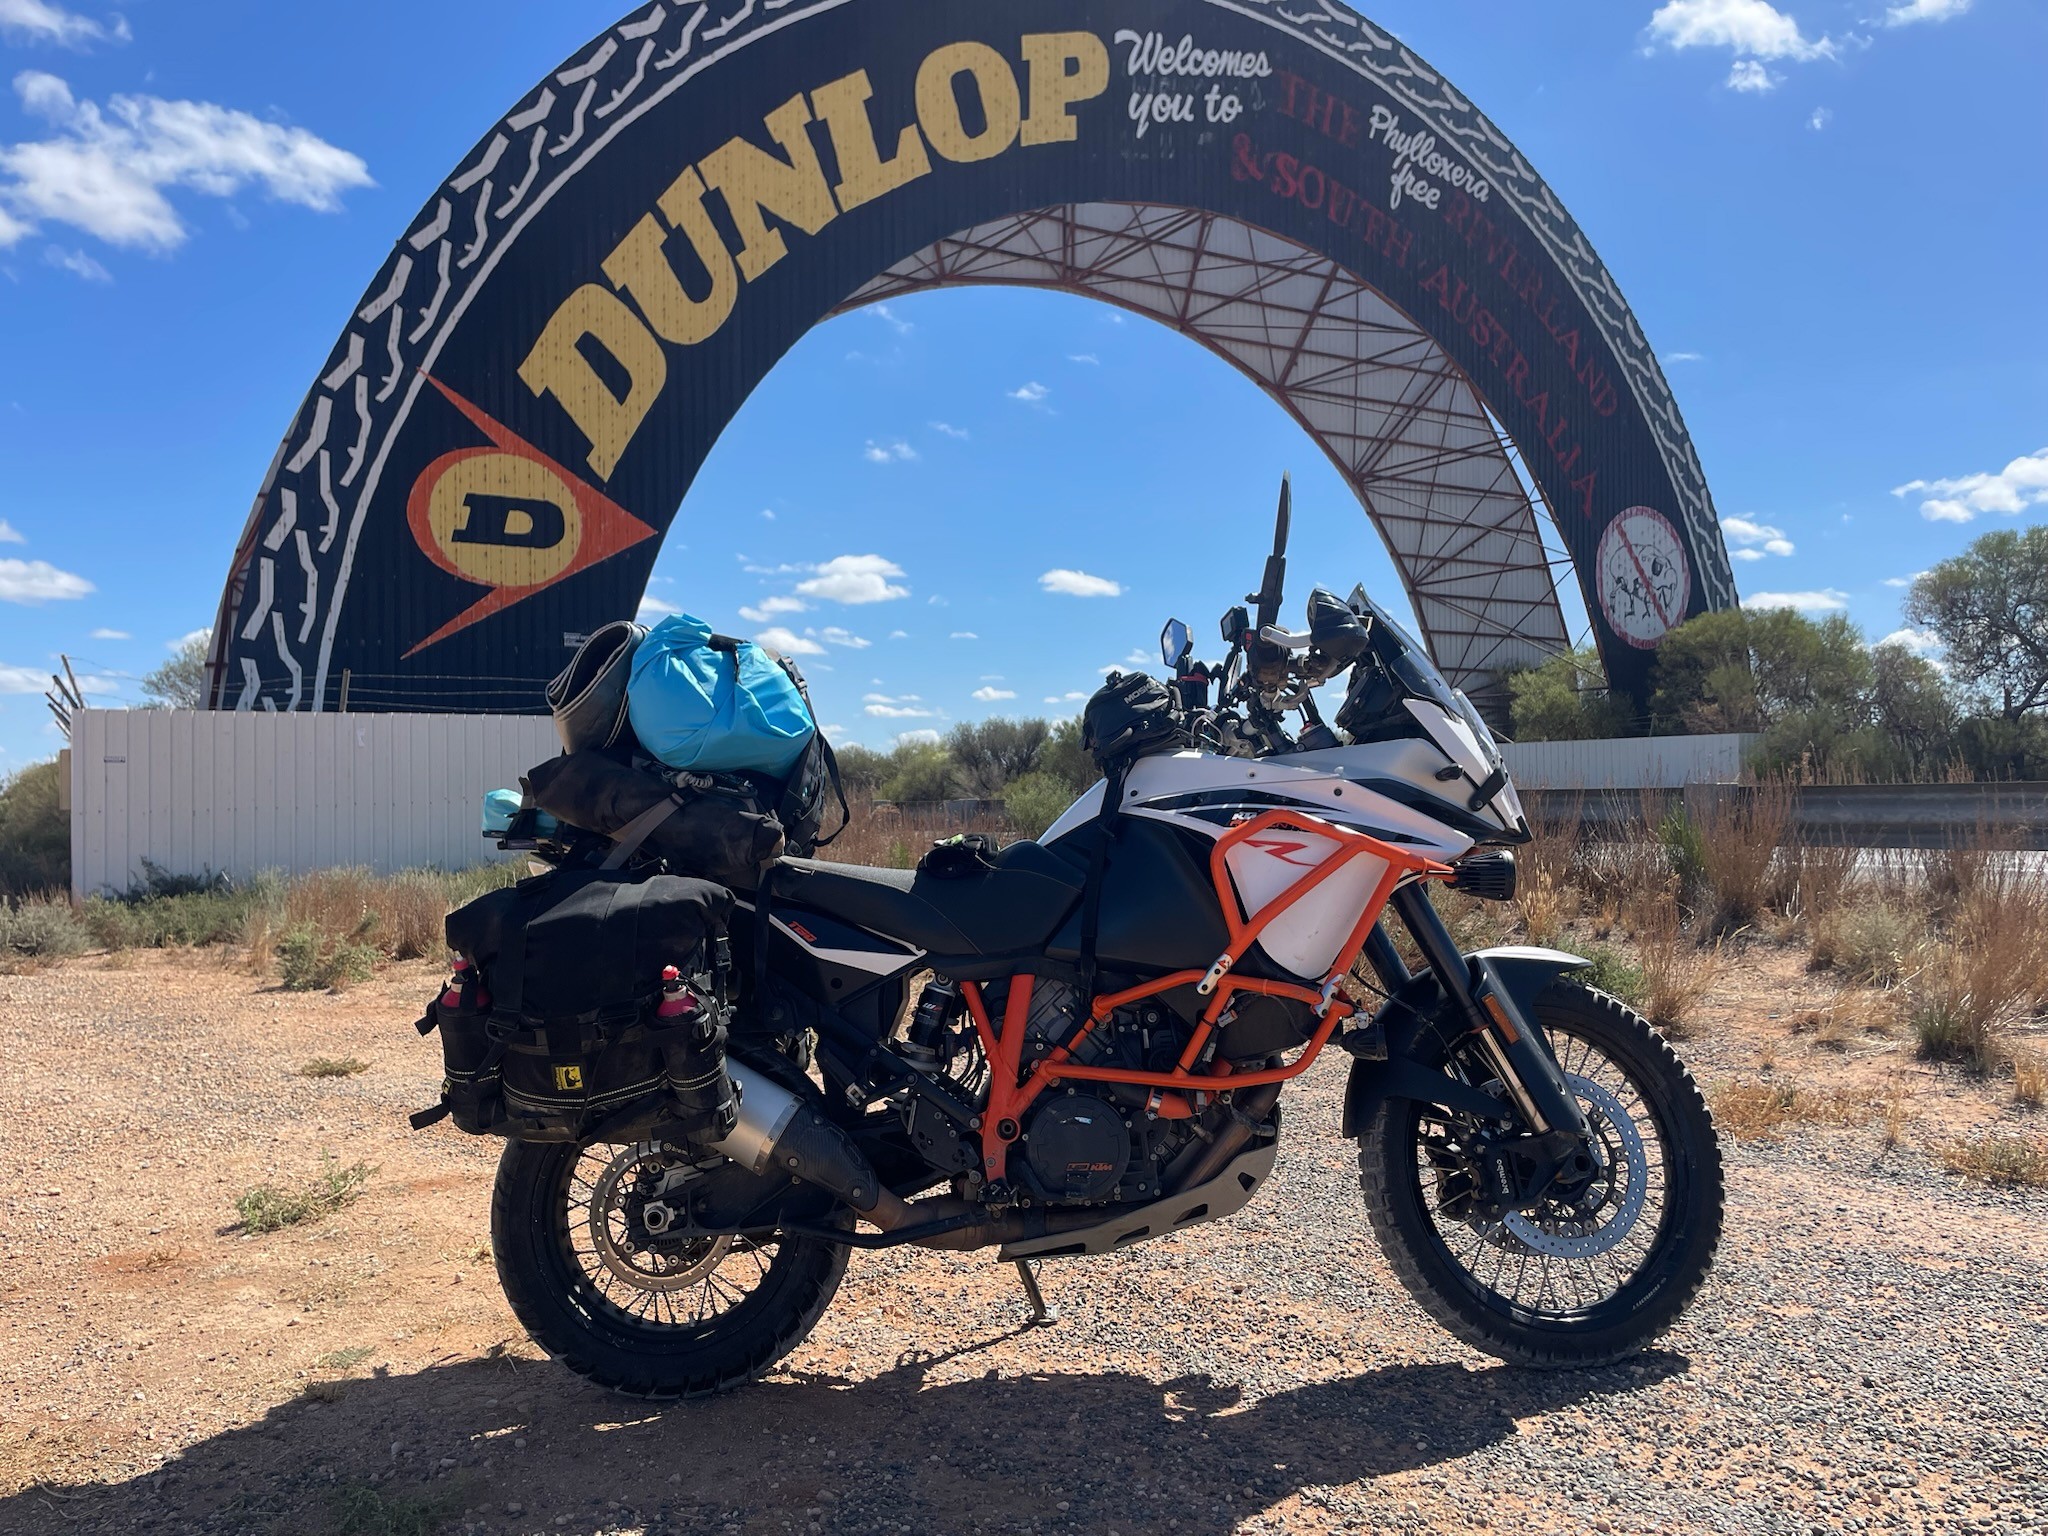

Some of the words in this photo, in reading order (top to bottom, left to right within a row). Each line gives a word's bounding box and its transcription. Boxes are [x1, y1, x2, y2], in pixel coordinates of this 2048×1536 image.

[1114, 28, 1272, 79] Welcomes
[1128, 91, 1195, 139] you
[1204, 84, 1243, 123] to
[1275, 68, 1362, 148] THE
[1369, 104, 1489, 203] Phylloxera
[1390, 162, 1442, 210] free
[517, 31, 1111, 483] DUNLOP
[1230, 132, 1265, 182] &
[1270, 152, 1414, 268] SOUTH
[1418, 263, 1597, 519] AUSTRALIA
[451, 493, 566, 549] D
[1496, 1158, 1510, 1194] brembo
